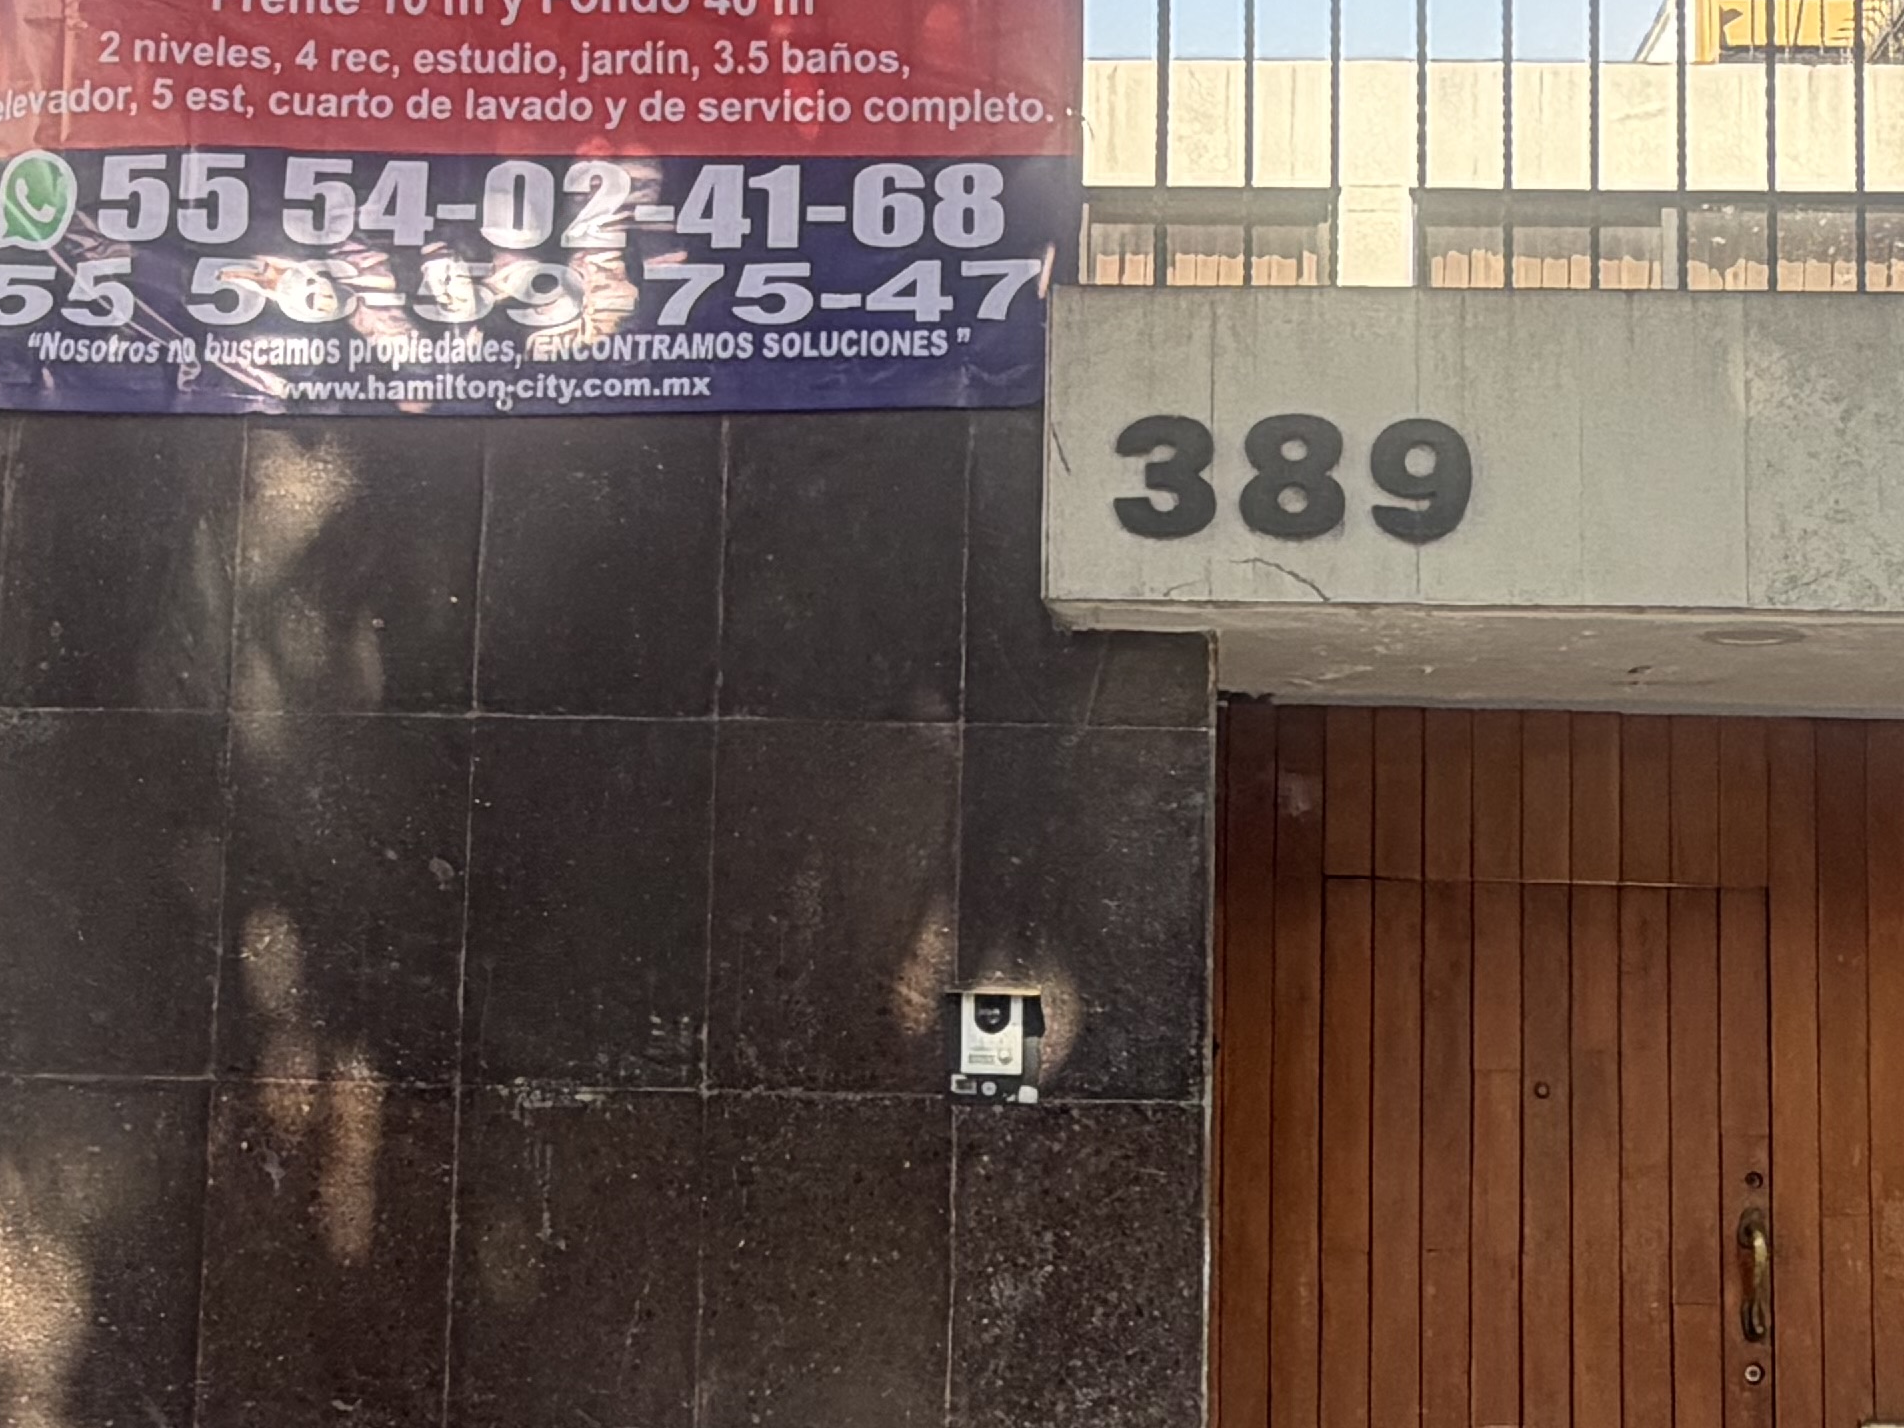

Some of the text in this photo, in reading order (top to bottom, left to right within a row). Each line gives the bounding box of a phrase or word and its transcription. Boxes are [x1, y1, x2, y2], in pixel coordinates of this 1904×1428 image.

[98, 31, 911, 83] 2 niveles, 4 rec, estudio, jardín, 3.5 baños,
[150, 78, 174, 111] 5
[185, 83, 254, 119] est,
[268, 88, 395, 120] cuarto
[405, 86, 452, 121] de
[465, 88, 594, 123] lavado
[603, 96, 627, 130] y
[638, 89, 686, 123] de
[697, 88, 853, 124] servicio
[862, 88, 1055, 131] completo.
[97, 152, 1006, 250] 55 54-02-41-68
[166, 336, 196, 364] no
[204, 332, 341, 366] buscamos
[348, 329, 521, 373] propiedades,
[532, 332, 754, 362] ENCONTRAMOS
[761, 329, 948, 359] SOLUCIONES
[284, 373, 712, 405] www.hamilton-city.com.mx
[1113, 413, 1472, 544] 389
